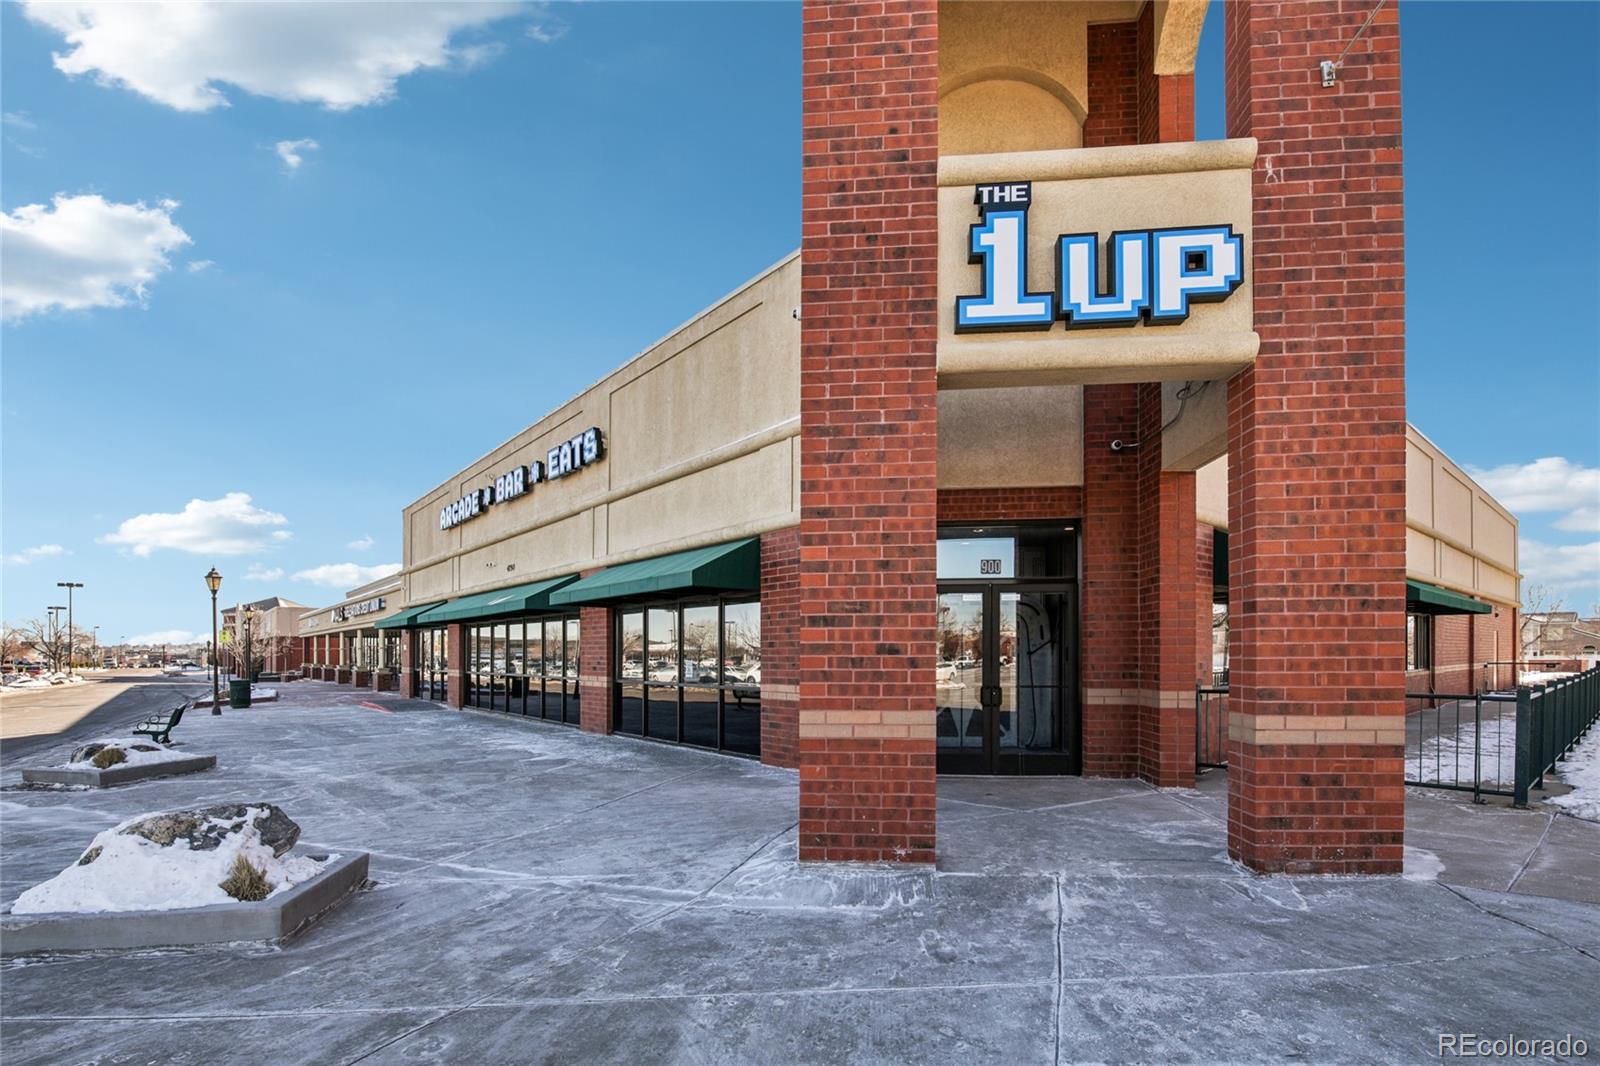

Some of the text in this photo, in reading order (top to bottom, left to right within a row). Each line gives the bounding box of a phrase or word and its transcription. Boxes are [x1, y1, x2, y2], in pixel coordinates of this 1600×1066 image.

[977, 184, 1029, 204] THE
[440, 428, 600, 530] ARCADE BAR EATS
[981, 560, 1002, 574] 900
